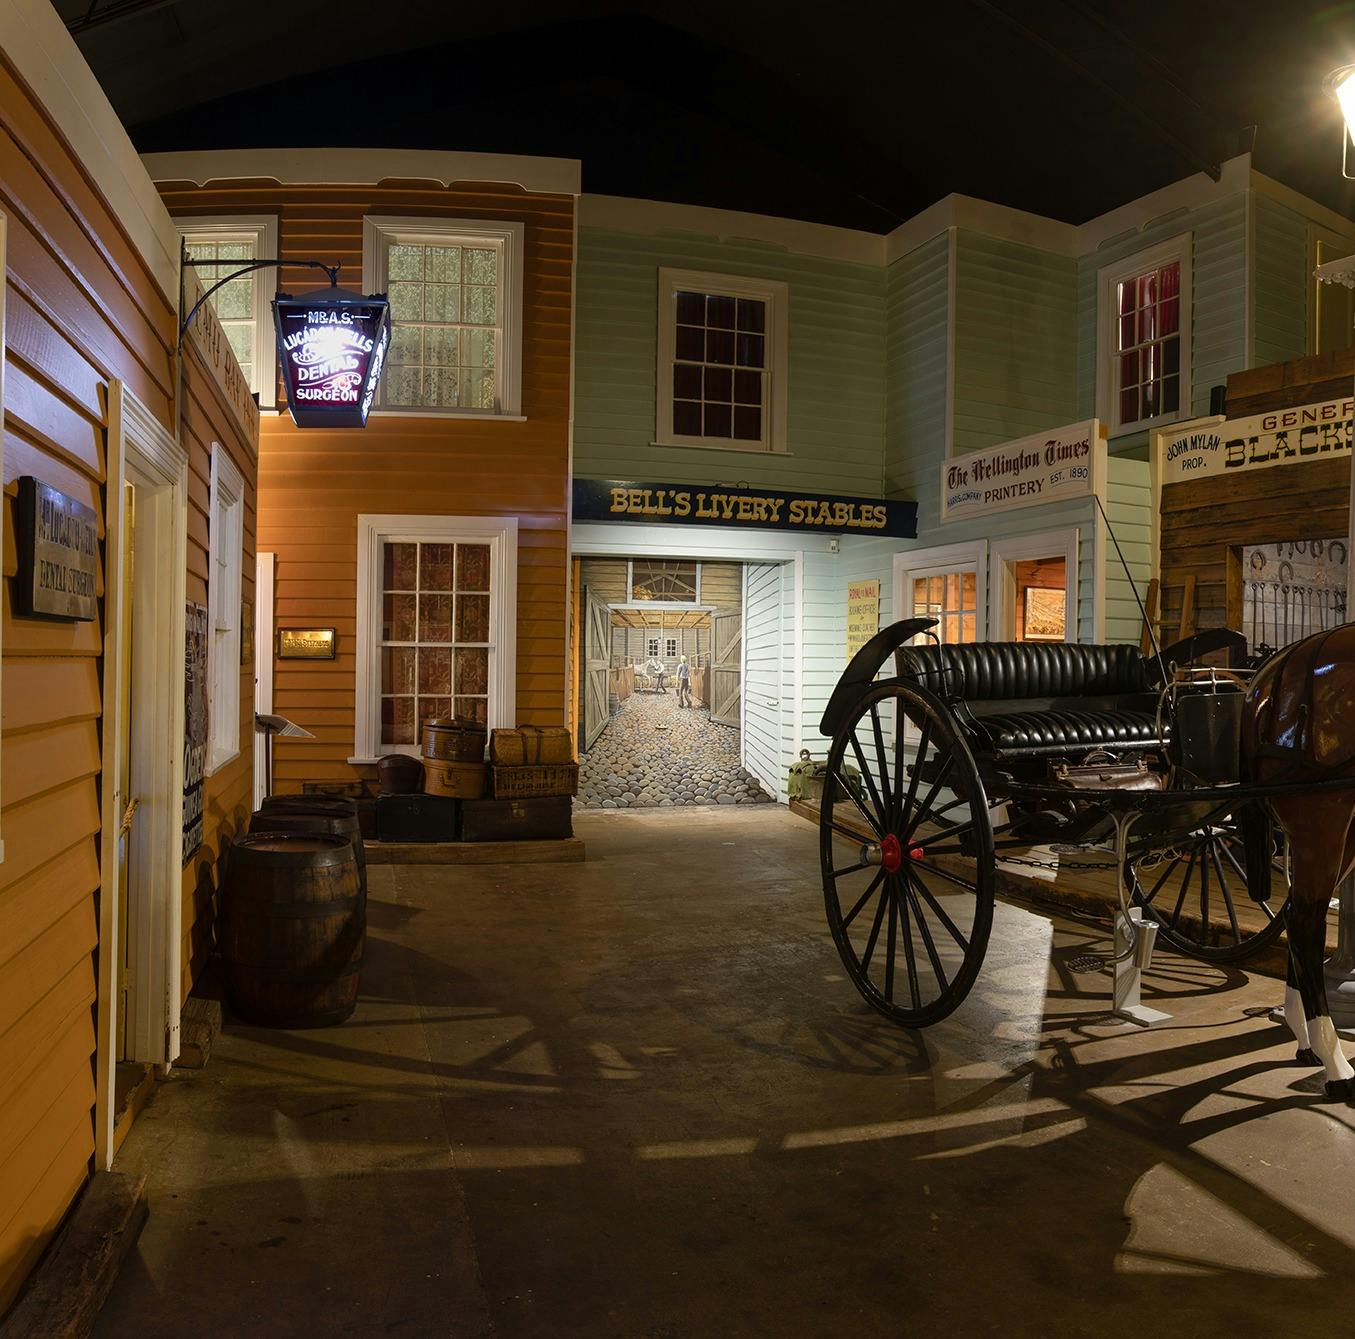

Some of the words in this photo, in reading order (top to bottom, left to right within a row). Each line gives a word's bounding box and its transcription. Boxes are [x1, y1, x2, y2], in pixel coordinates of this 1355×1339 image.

[296, 388, 358, 401] SURGEON
[1166, 437, 1189, 462] JOHN
[1190, 434, 1221, 452] MYLAN
[947, 465, 968, 490] The
[972, 449, 1040, 483] Wellington
[1044, 438, 1090, 466] Times
[1050, 471, 1065, 485] EST.
[1069, 467, 1089, 479] 1890
[1182, 456, 1207, 471] PROP.
[984, 478, 1045, 503] PRINTERY
[610, 488, 691, 516] BELL'S
[695, 492, 785, 522] LIVERY
[788, 499, 888, 529] STABLES
